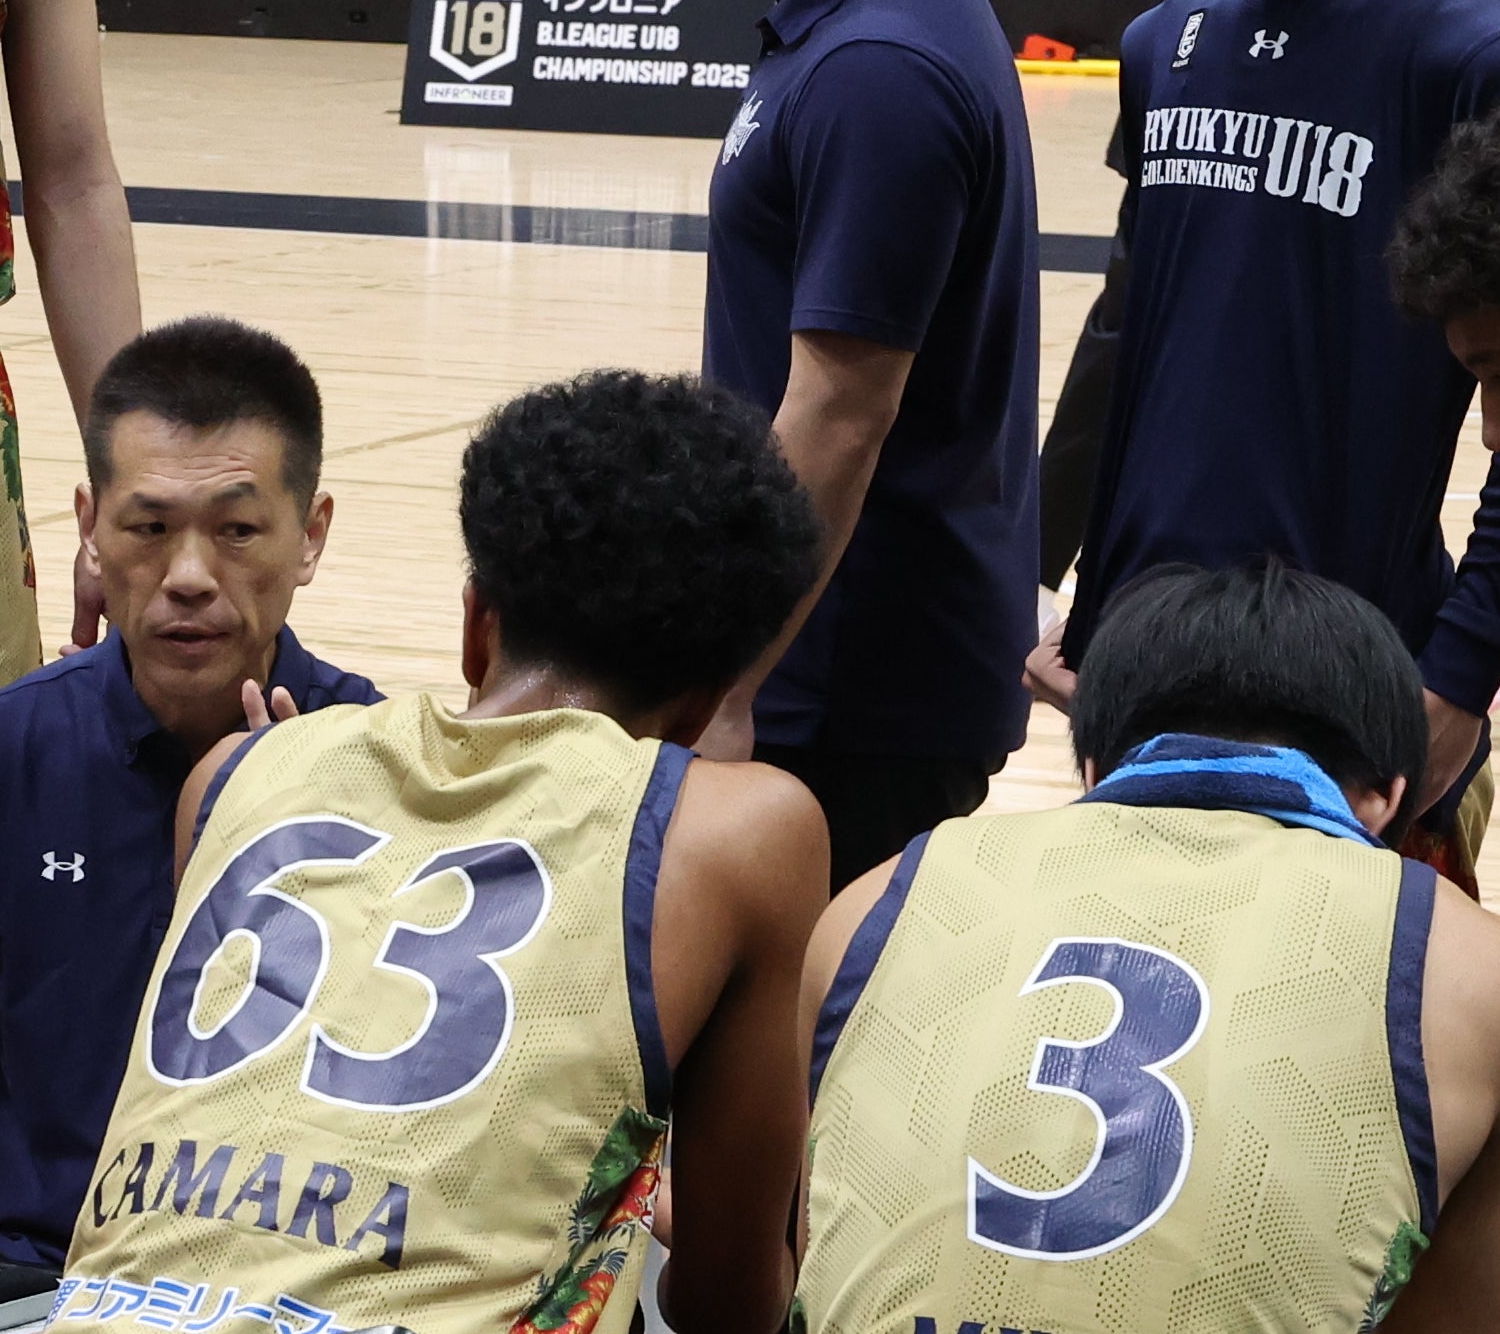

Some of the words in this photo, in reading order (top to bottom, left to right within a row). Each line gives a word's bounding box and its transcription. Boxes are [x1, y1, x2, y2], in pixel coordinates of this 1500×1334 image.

[450, 0, 506, 56] 18
[536, 20, 637, 51] B.LEAGUE
[640, 25, 680, 52] U18
[430, 87, 507, 101] INFRONEER
[533, 57, 688, 86] CHAMPIONSHIP
[691, 62, 751, 89] 2025
[1142, 107, 1271, 158] RYUKYU
[1264, 117, 1374, 217] U18
[146, 814, 553, 1114] 63
[966, 936, 1211, 1262] 3
[93, 1139, 410, 1270] CAMARA
